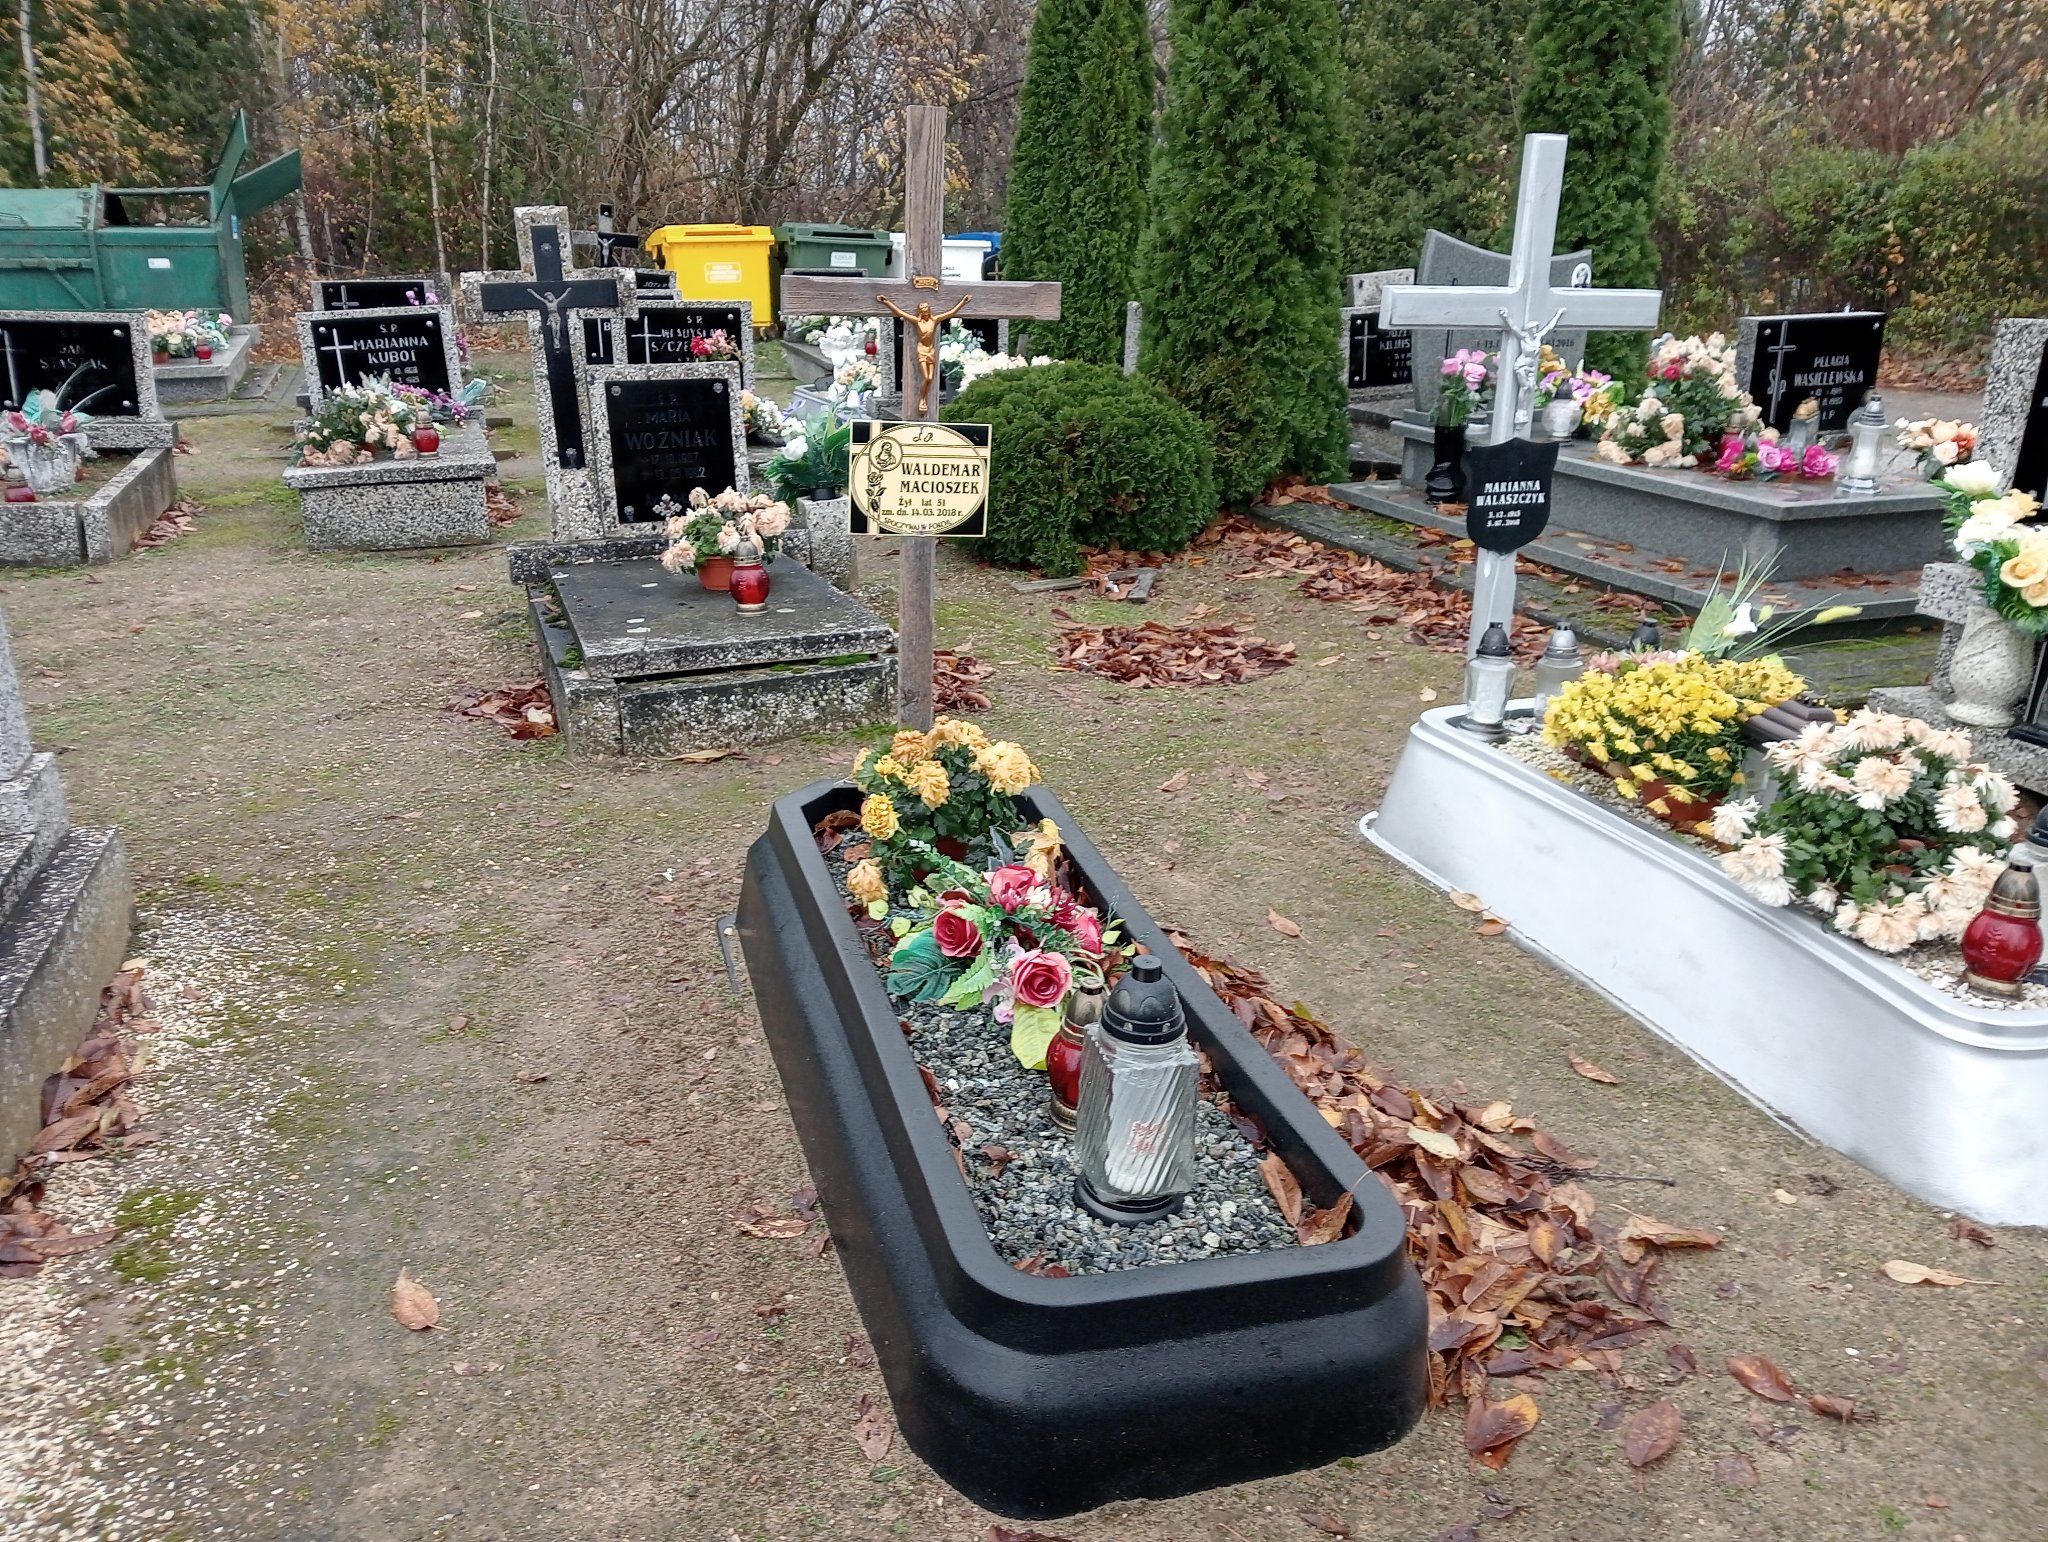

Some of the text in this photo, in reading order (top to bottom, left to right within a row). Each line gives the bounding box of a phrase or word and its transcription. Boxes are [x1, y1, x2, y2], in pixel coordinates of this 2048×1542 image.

[353, 335, 429, 351] MARIANNA
[1814, 355, 1850, 368] PELAGIA
[1794, 370, 1864, 387] WASIELEWSKA
[646, 409, 692, 424] MARIA
[901, 462, 981, 477] WALDEMAR
[899, 480, 980, 494] MACIOSZEK
[1484, 480, 1541, 493] MARIANNA
[898, 496, 946, 508] Żył lat 51
[1476, 492, 1546, 506] WALASZCZYK
[881, 509, 895, 517] zm.
[896, 507, 909, 517] dn.
[936, 508, 956, 517] 2018
